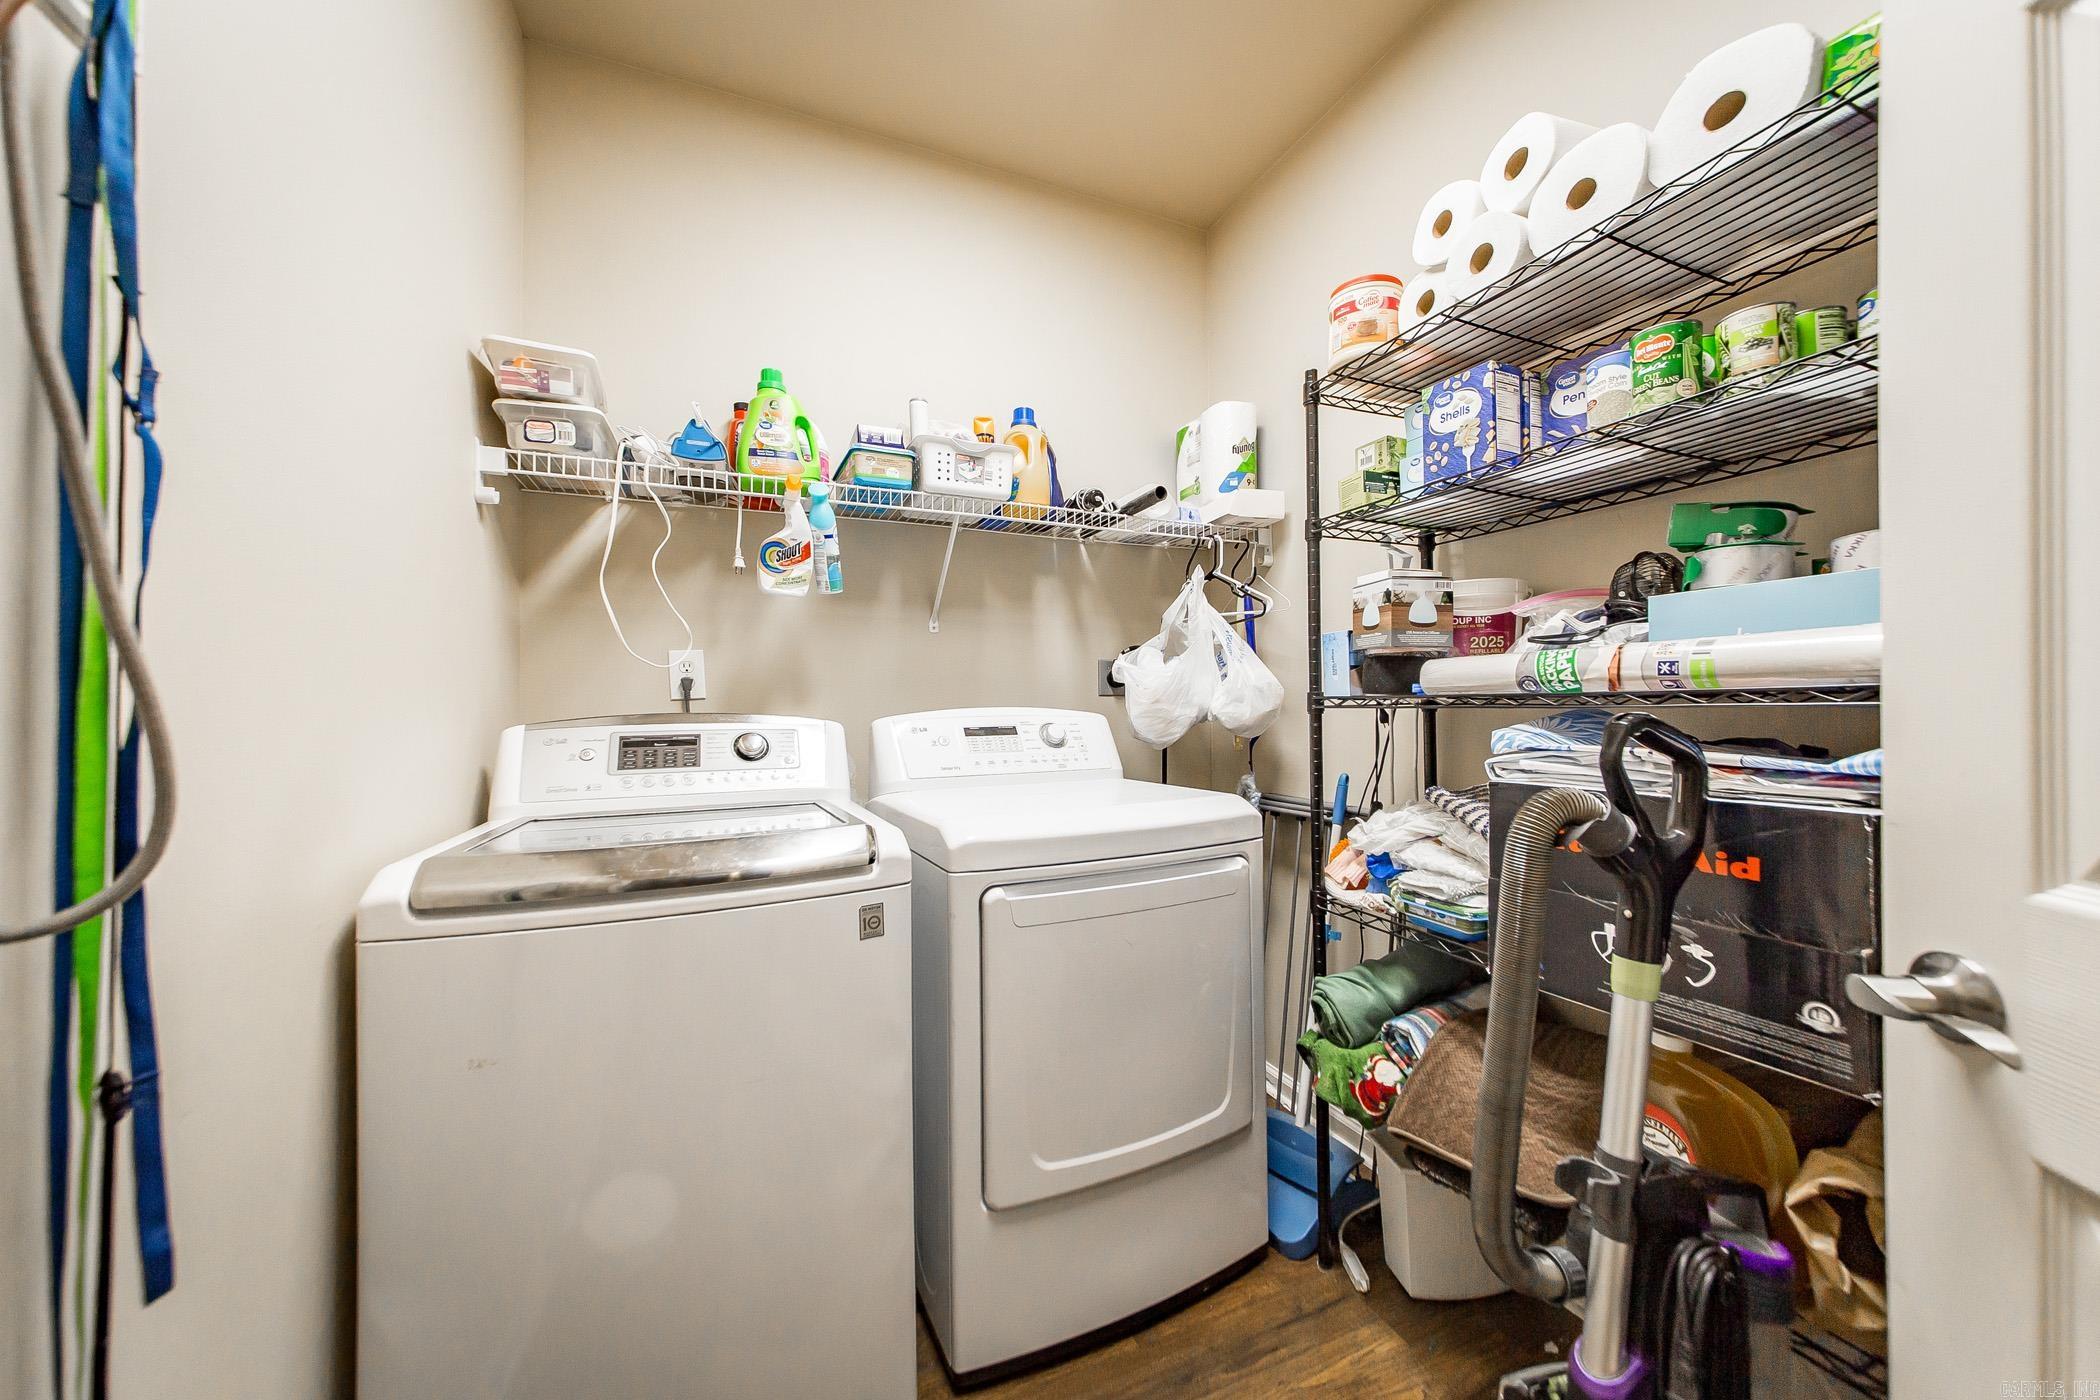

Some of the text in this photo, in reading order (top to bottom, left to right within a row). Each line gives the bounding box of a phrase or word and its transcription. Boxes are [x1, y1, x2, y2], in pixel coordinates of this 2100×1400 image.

[1643, 372, 1661, 383] CUT
[1652, 375, 1680, 388] BEANS
[1440, 406, 1470, 424] Shells
[1232, 441, 1255, 454] Bounty
[775, 541, 802, 562] SHOUT
[1475, 616, 1492, 624] INC
[1470, 635, 1504, 648] 2025
[1694, 850, 1761, 882] Aid
